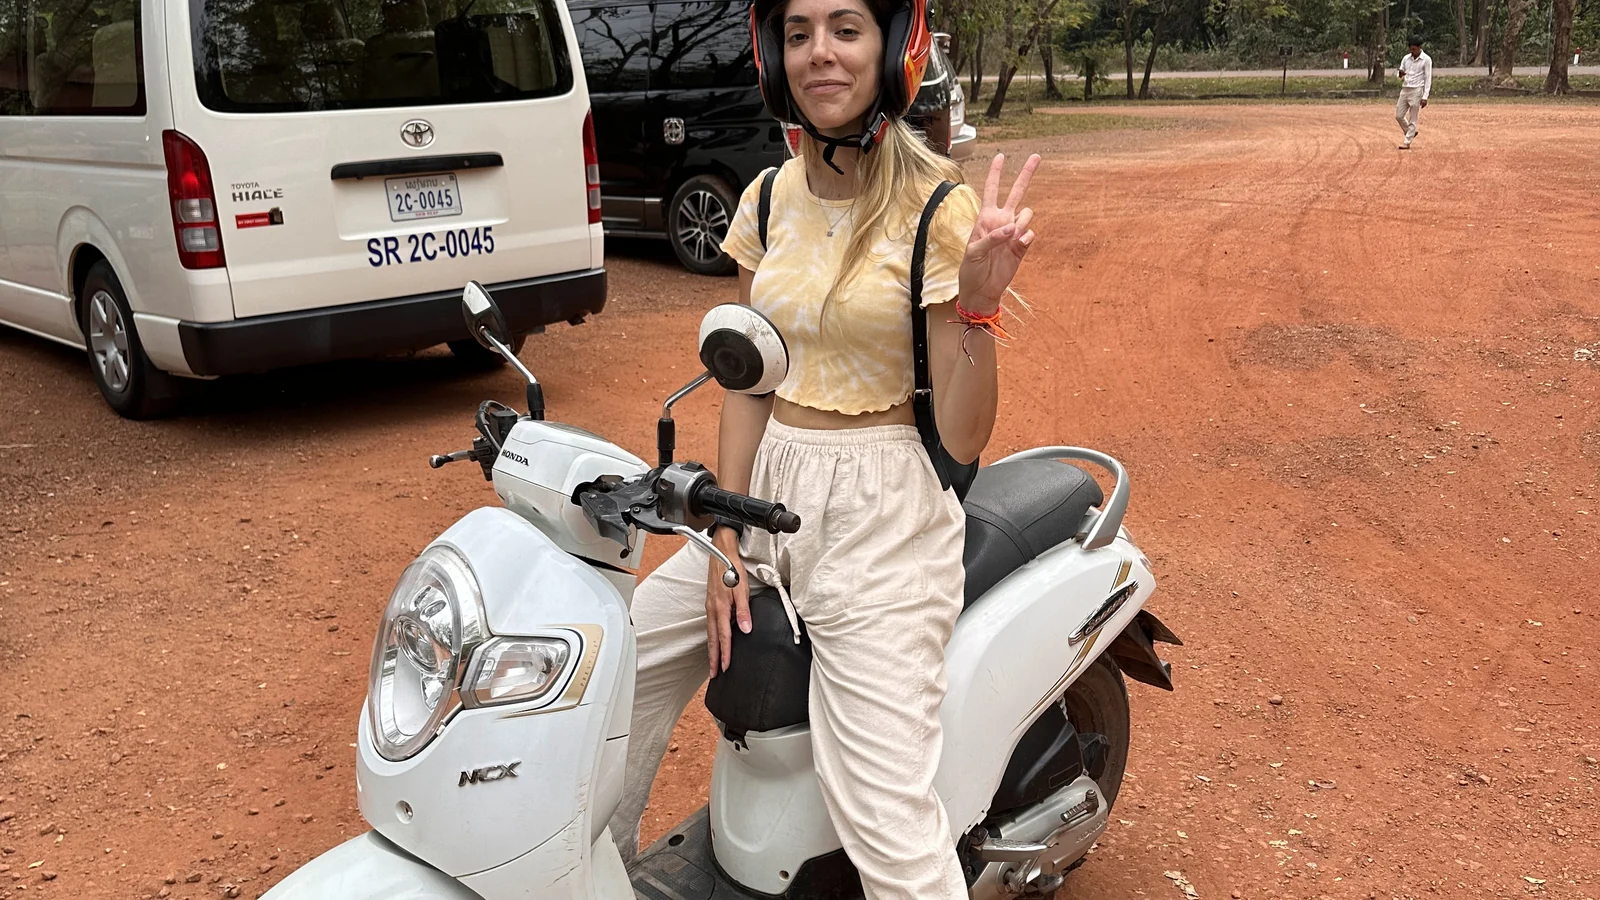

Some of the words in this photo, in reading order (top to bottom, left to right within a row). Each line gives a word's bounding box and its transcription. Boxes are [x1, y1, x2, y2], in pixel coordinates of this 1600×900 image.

[231, 182, 260, 190] TOYOTA
[232, 188, 284, 202] HIACE
[395, 189, 453, 213] 2C-0045
[367, 236, 403, 267] SR
[408, 226, 495, 263] 2C-0045
[501, 449, 529, 466] HONDA
